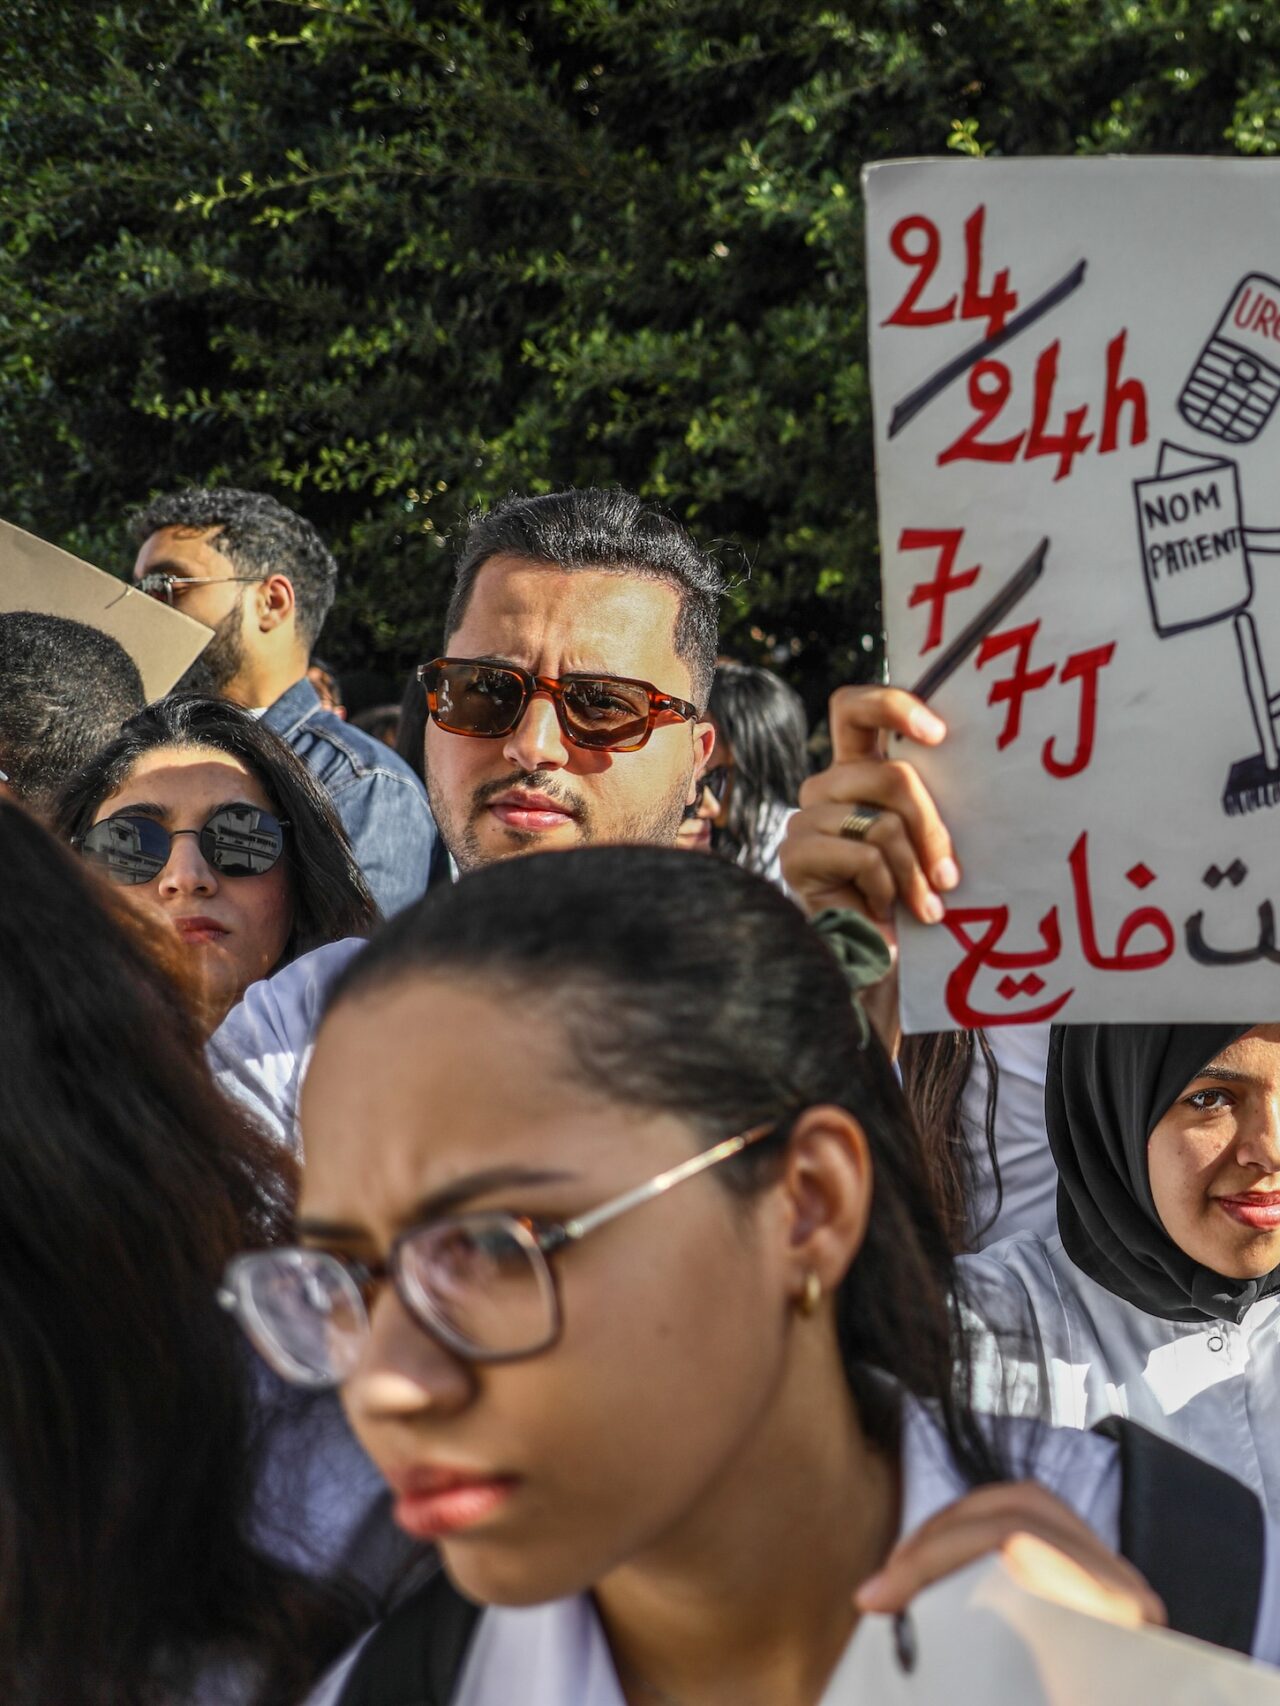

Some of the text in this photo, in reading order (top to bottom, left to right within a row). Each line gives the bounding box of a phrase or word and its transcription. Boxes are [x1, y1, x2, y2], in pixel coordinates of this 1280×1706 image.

[937, 328, 1148, 482] 24h
[1144, 483, 1221, 529] NOM
[976, 620, 1116, 779] 7J
